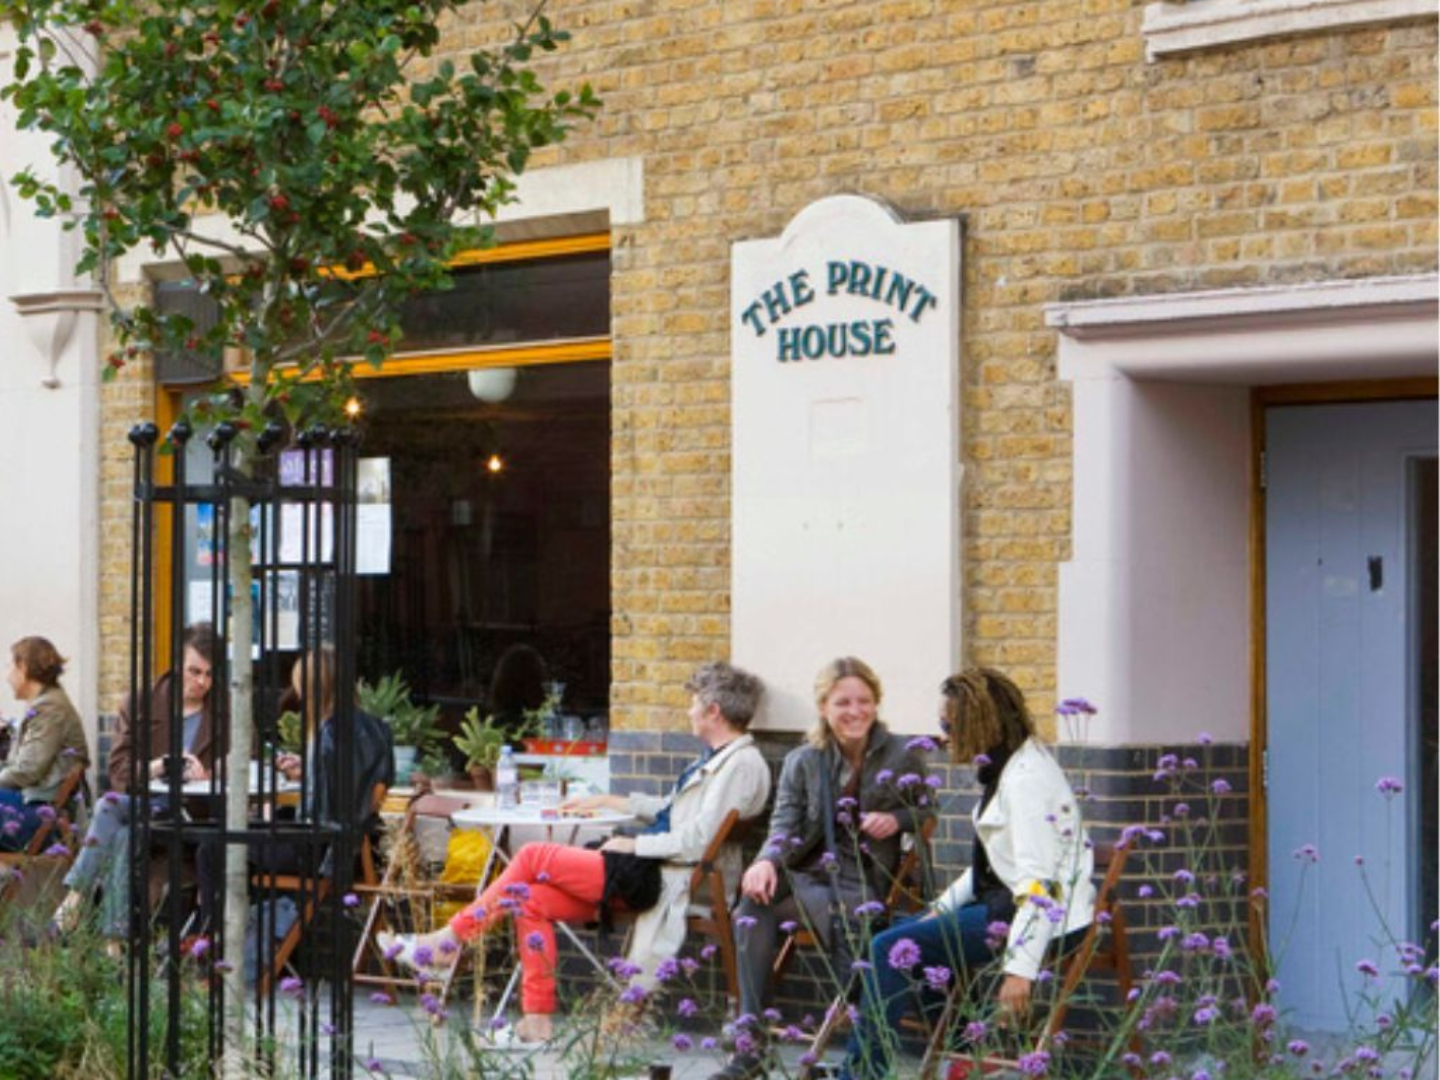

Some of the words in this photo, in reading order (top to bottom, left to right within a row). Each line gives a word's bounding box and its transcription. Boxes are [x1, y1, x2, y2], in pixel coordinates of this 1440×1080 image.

[741, 268, 815, 337] THE
[826, 260, 937, 323] PRINT
[777, 318, 896, 362] HOUSE
